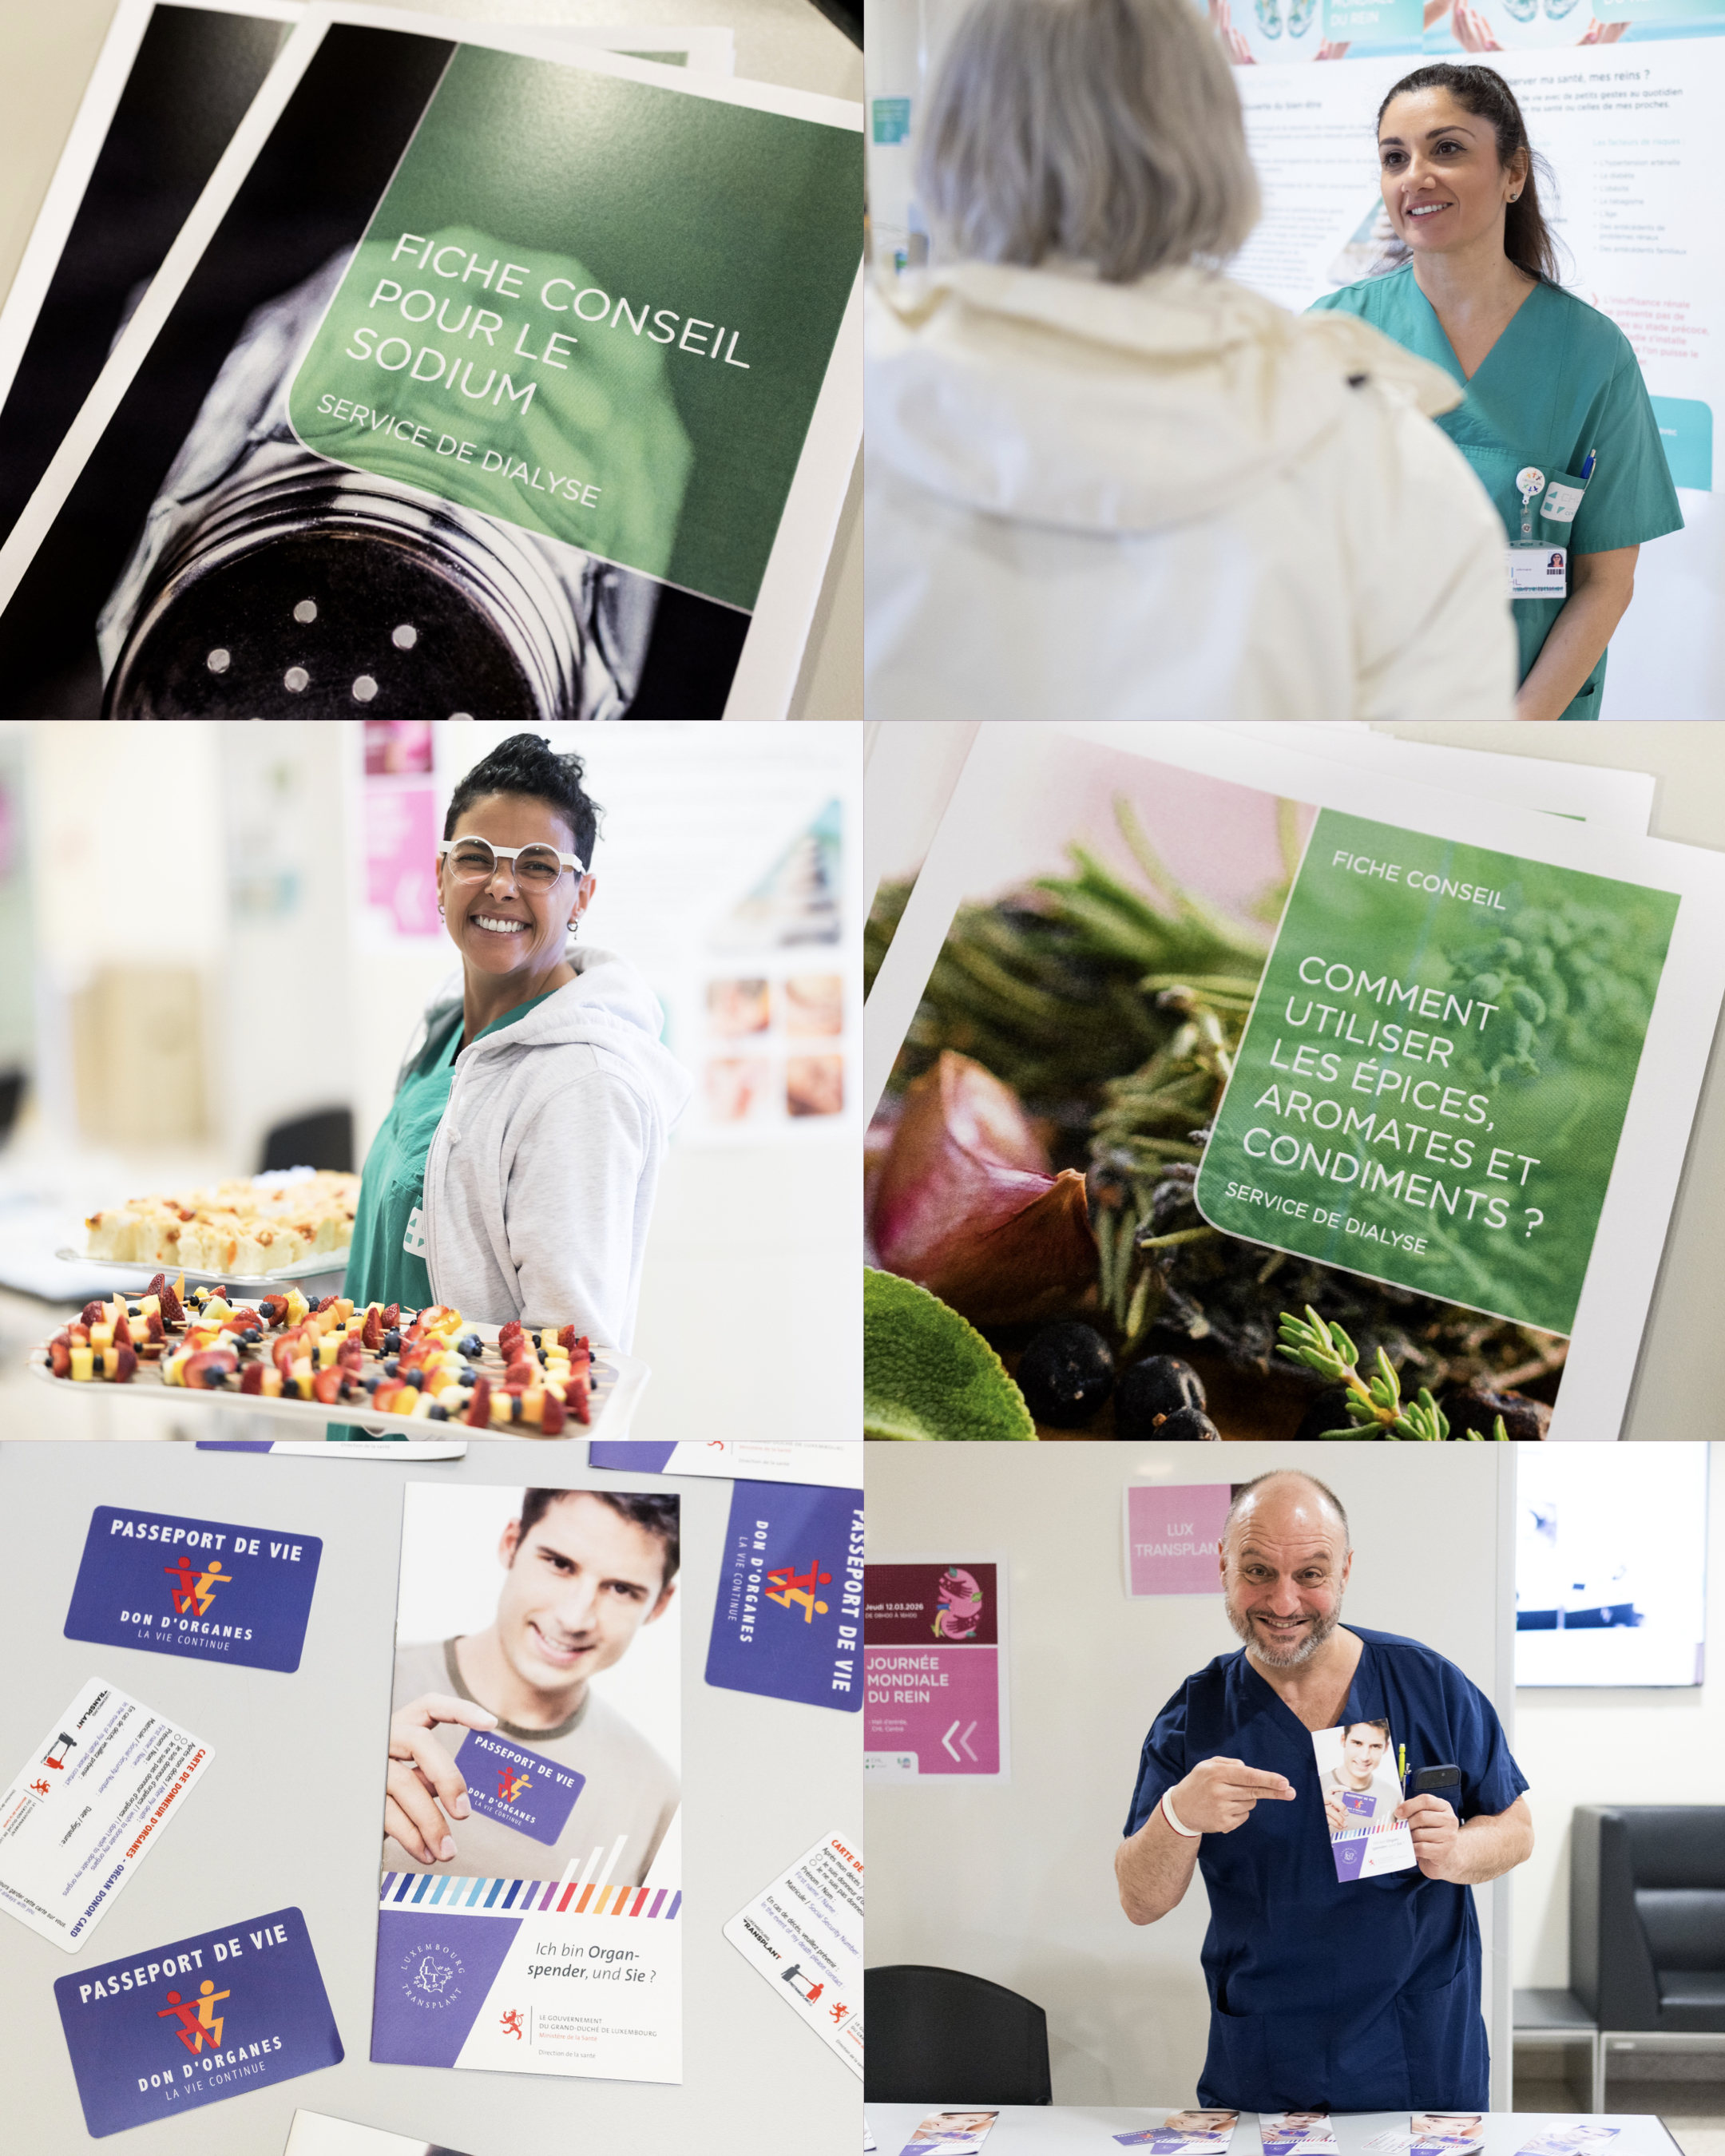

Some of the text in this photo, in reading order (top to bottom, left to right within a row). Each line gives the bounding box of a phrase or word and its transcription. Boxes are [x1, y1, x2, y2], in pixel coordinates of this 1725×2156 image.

[1589, 73, 1611, 82] mes
[1614, 70, 1641, 81] reins
[1600, 90, 1627, 101] gestes
[1643, 88, 1683, 98] quotidien
[391, 232, 751, 369] FICHE CONSEIL
[368, 279, 578, 370] POUR LE
[345, 327, 537, 415] SODIUM
[317, 394, 602, 508] SERVICE DE DIALYSE
[1332, 850, 1506, 910] FICHE CONSEIL
[1299, 956, 1499, 1031] COMMENT
[1285, 996, 1454, 1068] UTILISER
[1269, 1038, 1494, 1132] LES ÉPICES,
[1254, 1084, 1541, 1187] AROMATES ET
[1243, 1128, 1544, 1239] CONDIMENTS ?
[1225, 1181, 1428, 1255] SERVICE DE DIALYSE
[110, 1520, 303, 1562] PASSEPORT DE VIE
[1167, 1524, 1194, 1537] LUX
[1135, 1543, 1219, 1557] TRANSPLAN
[728, 1536, 748, 1622] LA VIE CONTINUE
[740, 1520, 769, 1643] DON D'ORGANES
[865, 1602, 924, 1611] Jeudi 12.03.2026
[120, 1611, 252, 1641] DON D'ORGANES
[837, 1625, 858, 1651] DE
[137, 1629, 230, 1651] LA VIE CONTINUE
[866, 1655, 939, 1670] JOURNÉE
[831, 1660, 854, 1692] VIE
[867, 1674, 949, 1687] MONDIALE
[77, 1689, 106, 1729] TRANSPLANT
[868, 1690, 930, 1703] DU REIN
[168, 1751, 177, 1762] suis
[175, 1757, 184, 1767] mon
[182, 1742, 195, 1757] Après
[186, 1748, 205, 1771] CARTE
[474, 1736, 575, 1788] PASSEPORT DE VIE
[154, 1761, 170, 1781] donneur
[165, 1767, 177, 1782] décès
[179, 1772, 189, 1782] DE
[136, 1780, 157, 1805] d'organes
[154, 1785, 165, 1797] After
[154, 1782, 181, 1817] DONNEUR
[125, 1811, 135, 1822] wish
[139, 1805, 151, 1820] death
[468, 1787, 536, 1824] DON D'ORGANES
[494, 1809, 522, 1826] CONTINUE
[109, 1828, 123, 1845] donate
[125, 1817, 157, 1858] D'ORGANES
[89, 1852, 104, 1870] organs
[831, 1839, 863, 1872] CARTE DE
[103, 1864, 124, 1889] ORGAN
[84, 1890, 105, 1916] DONOR
[69, 1916, 86, 1937] CARD
[785, 1880, 807, 1901] Matricule
[808, 1903, 823, 1918] Social
[821, 1916, 841, 1938] Security
[839, 1936, 859, 1956] Number
[743, 1918, 781, 1960] TRANSPLANT
[79, 1924, 288, 2003] PASSEPORT DE VIE
[401, 1943, 466, 1975] LUXEMBOURG
[536, 1942, 640, 1964] Ich bin Organ-
[527, 1963, 656, 1984] spender, und Sie ?
[401, 1983, 462, 2009] TRANSPLANT
[548, 2015, 602, 2024] GOUVERNEMENT
[550, 2023, 600, 2033] GRAND-DUCHÉ
[611, 2027, 657, 2037] LUXEMBOURG
[138, 2036, 283, 2092] DON D'ORGANES
[165, 2061, 267, 2100] LA VIE CONTINUE
